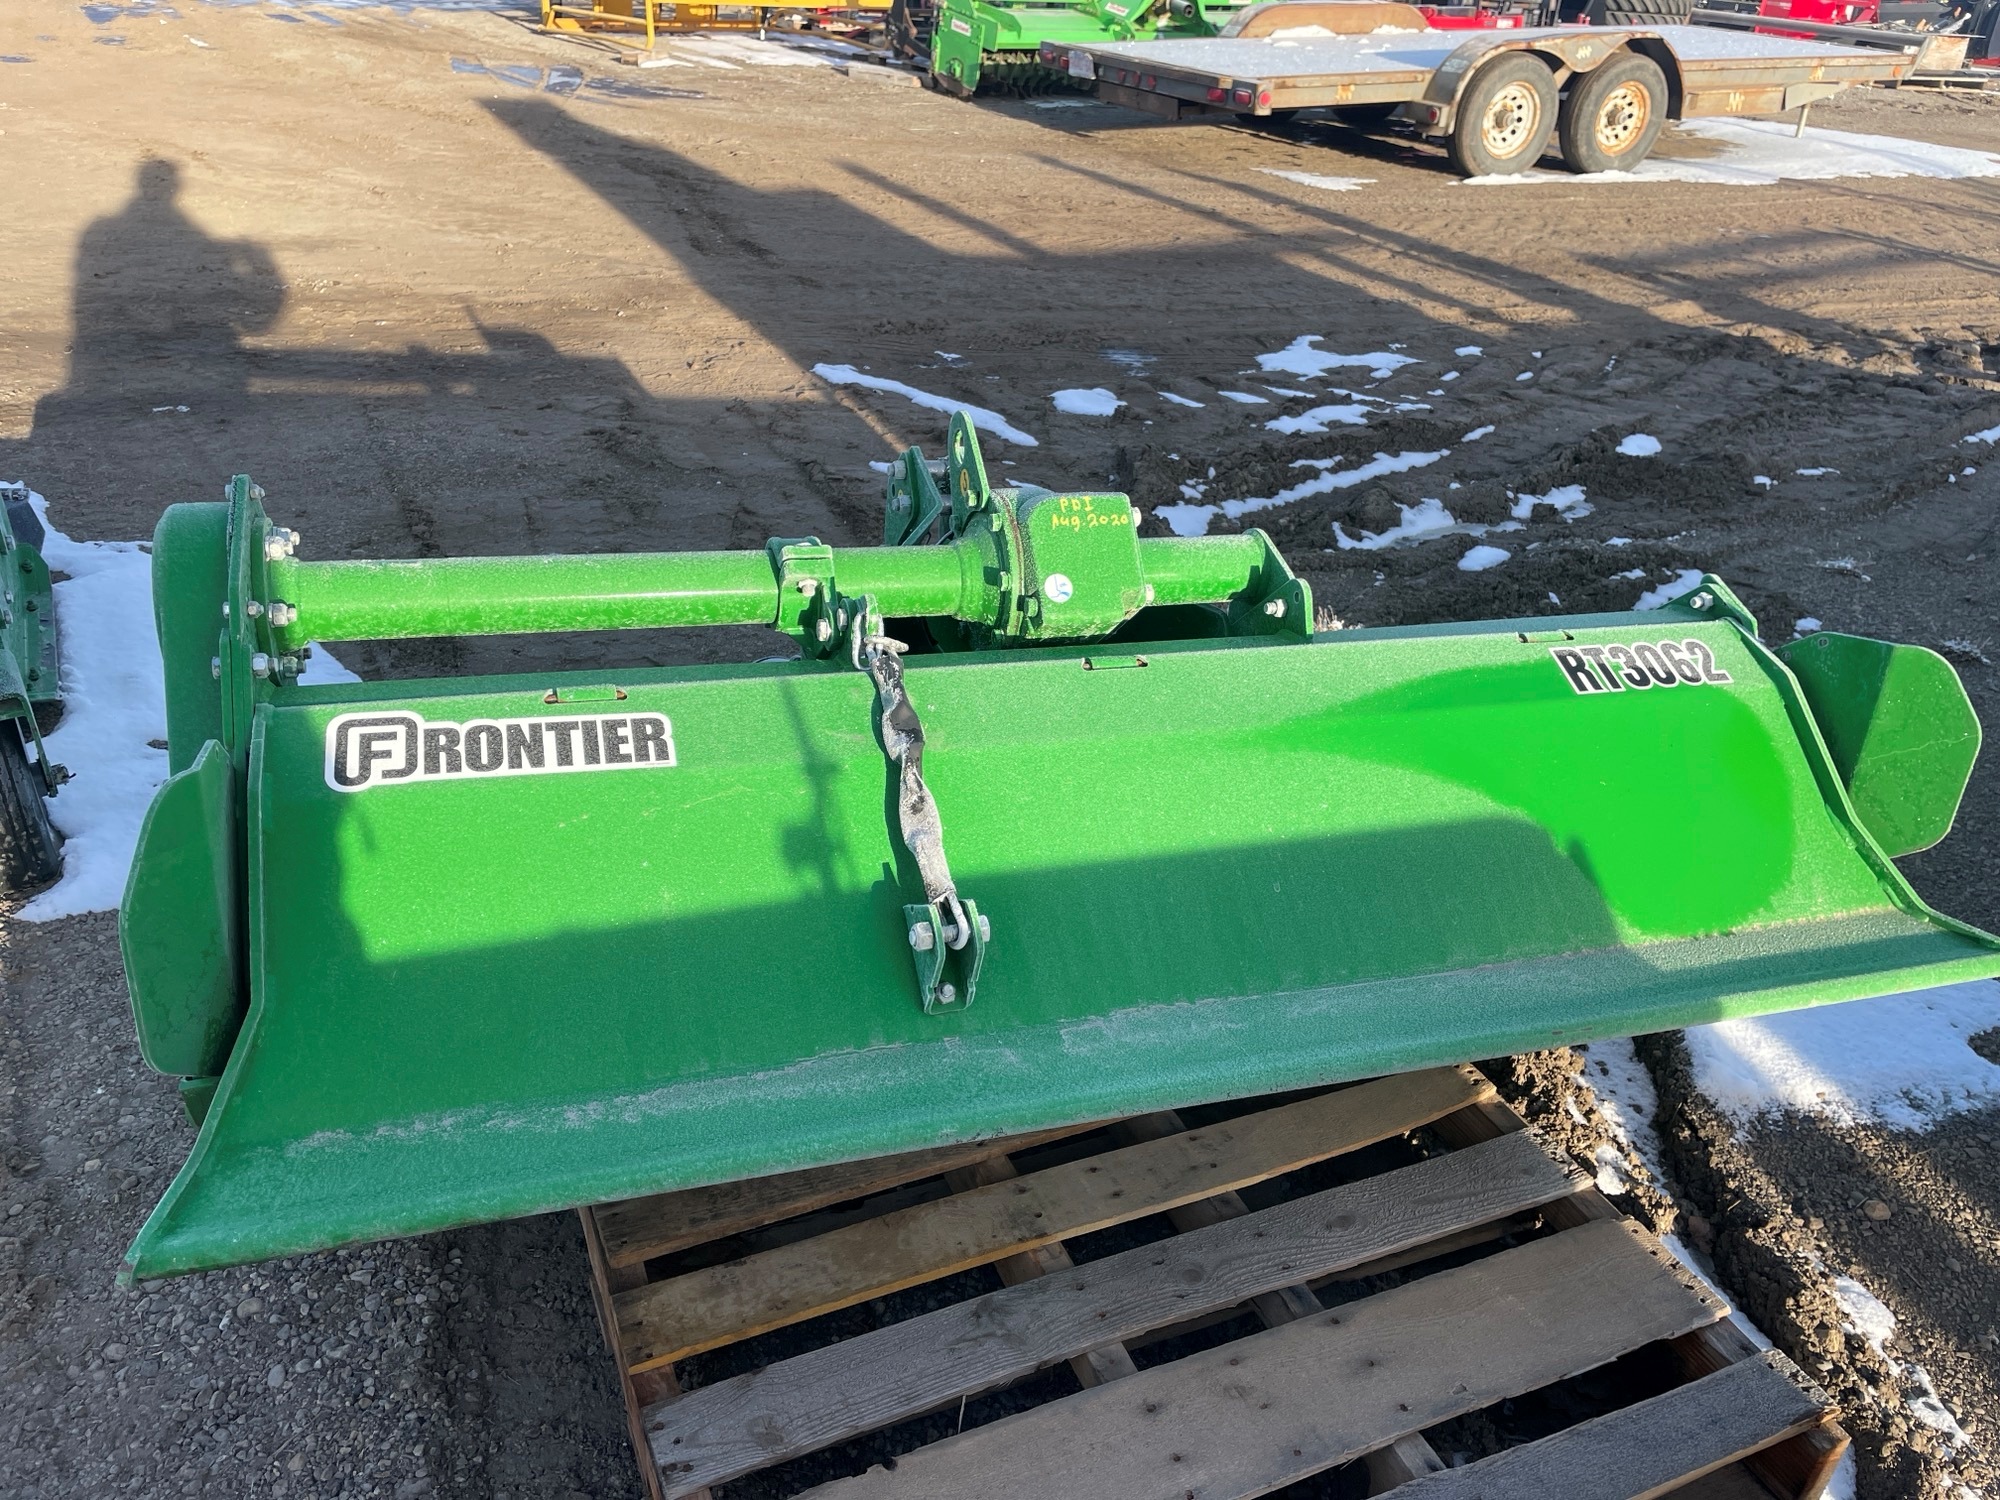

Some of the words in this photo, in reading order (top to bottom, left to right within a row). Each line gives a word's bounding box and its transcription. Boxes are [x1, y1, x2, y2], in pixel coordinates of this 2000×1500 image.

[1059, 495, 1093, 513] PDI
[1087, 513, 1129, 528] 2020
[1552, 640, 1731, 692] RT3062
[333, 715, 671, 787] FRONTIER
